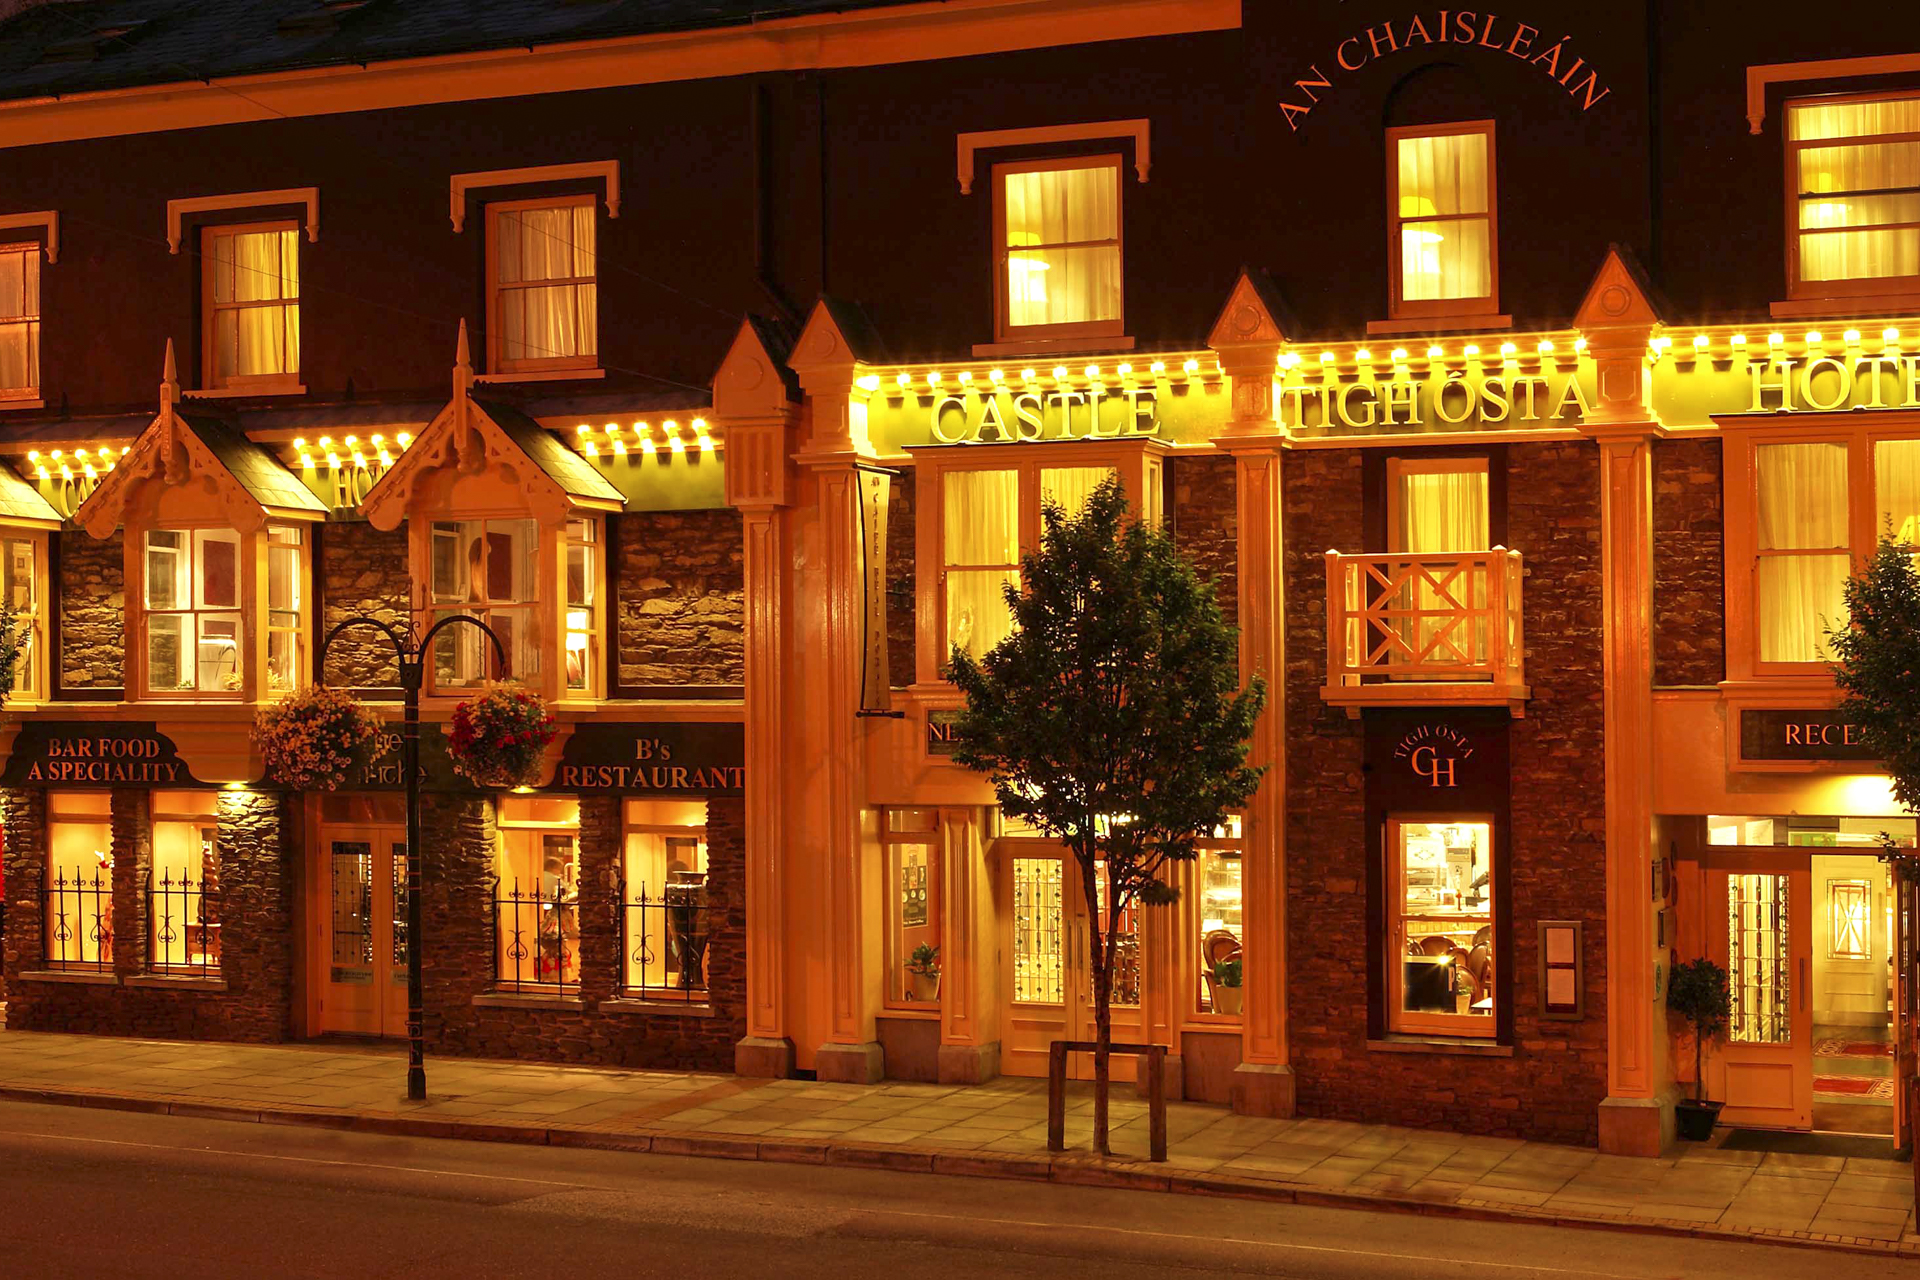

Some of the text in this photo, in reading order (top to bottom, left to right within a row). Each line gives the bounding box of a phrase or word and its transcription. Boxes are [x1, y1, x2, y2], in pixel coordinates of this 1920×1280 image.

[1279, 10, 1611, 131] AN CHAISLEÁIN
[930, 389, 1161, 443] CASTLE
[1282, 370, 1593, 429] TIGH ÓSTA
[48, 738, 160, 758] BAR FOOD
[635, 738, 672, 761] B's
[1393, 724, 1429, 758] TIGH
[28, 760, 180, 782] A SPECIALITY
[562, 765, 746, 789] RESTAURANT
[1411, 746, 1458, 787] CH
